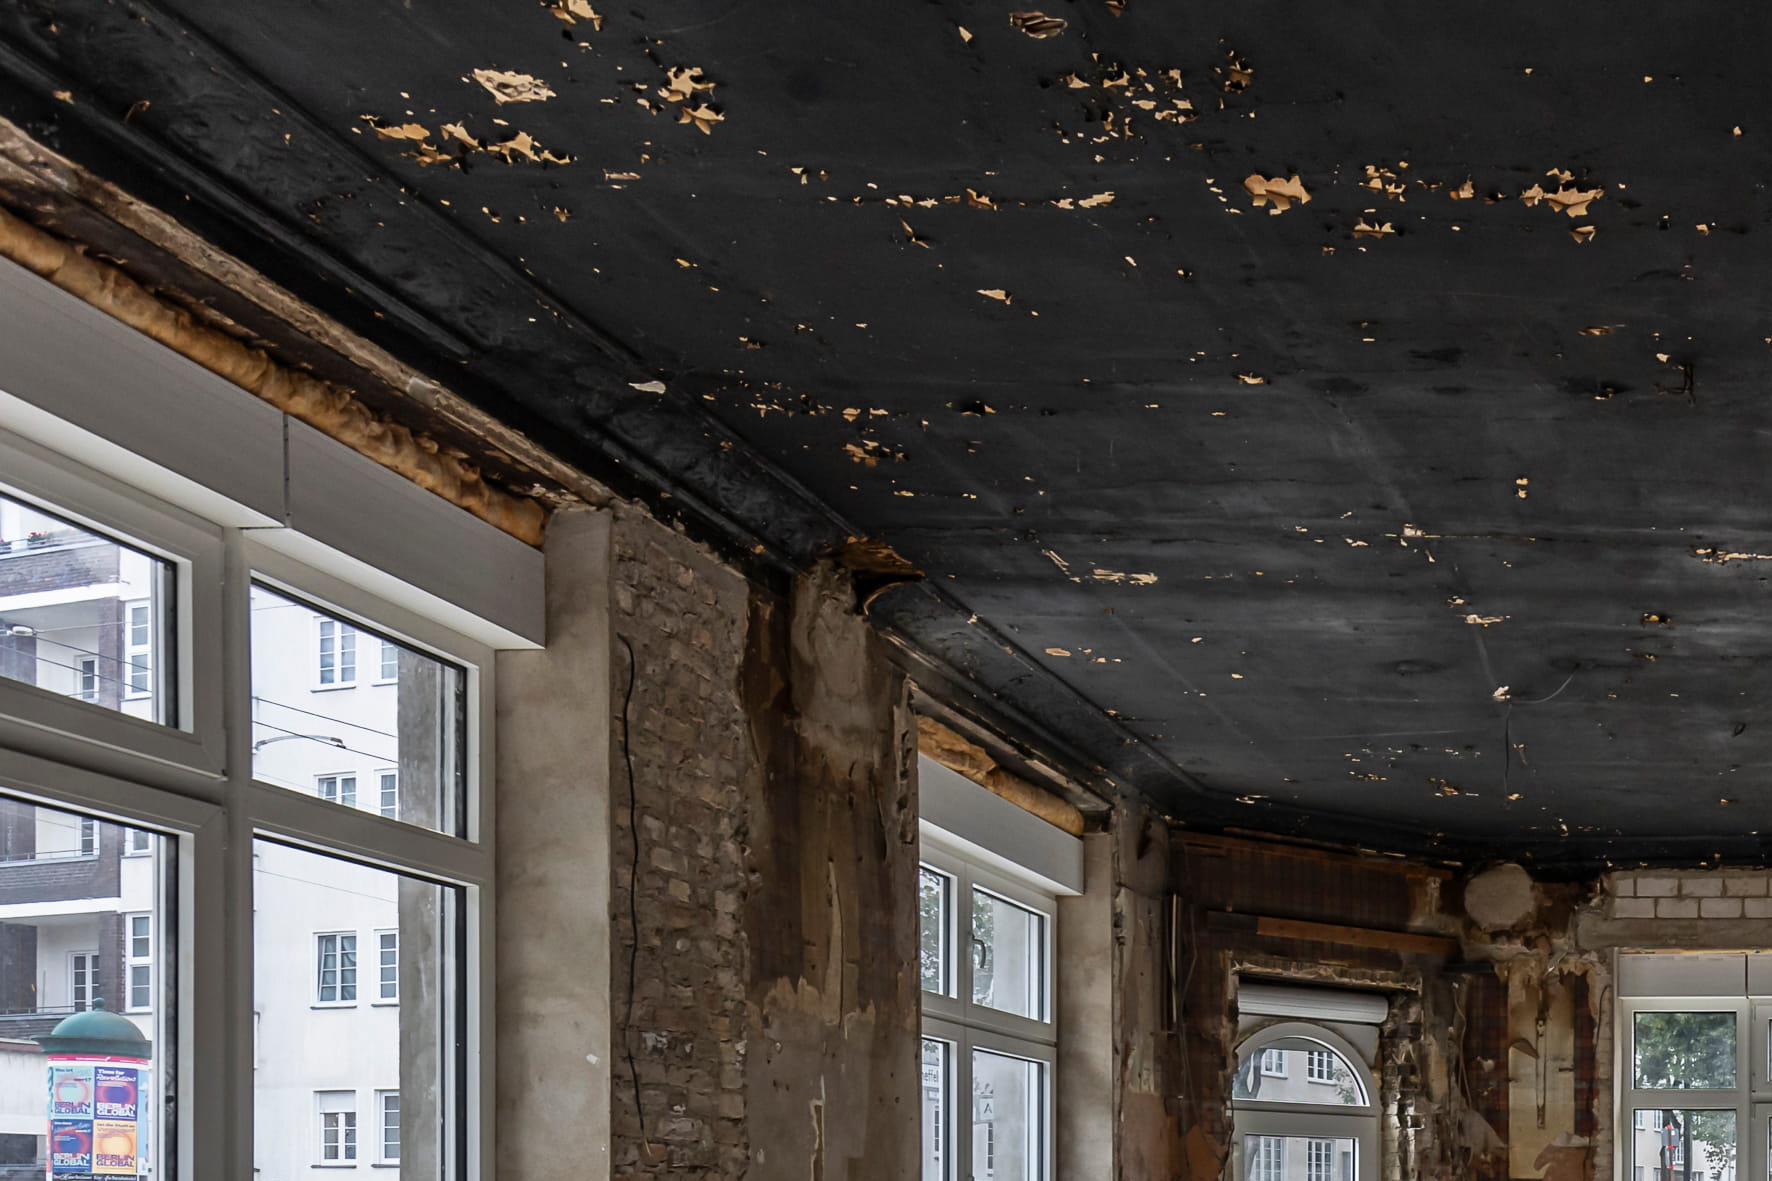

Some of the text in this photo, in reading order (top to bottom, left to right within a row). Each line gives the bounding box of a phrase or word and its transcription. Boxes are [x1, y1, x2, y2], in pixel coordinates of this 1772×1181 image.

[96, 1102, 136, 1111] BERLIN
[983, 1103, 993, 1114] A
[96, 1108, 136, 1117] GLOBAL
[53, 1152, 90, 1160] BERLIN
[96, 1153, 135, 1161] BERLIN
[96, 1159, 135, 1168] GLOBAL
